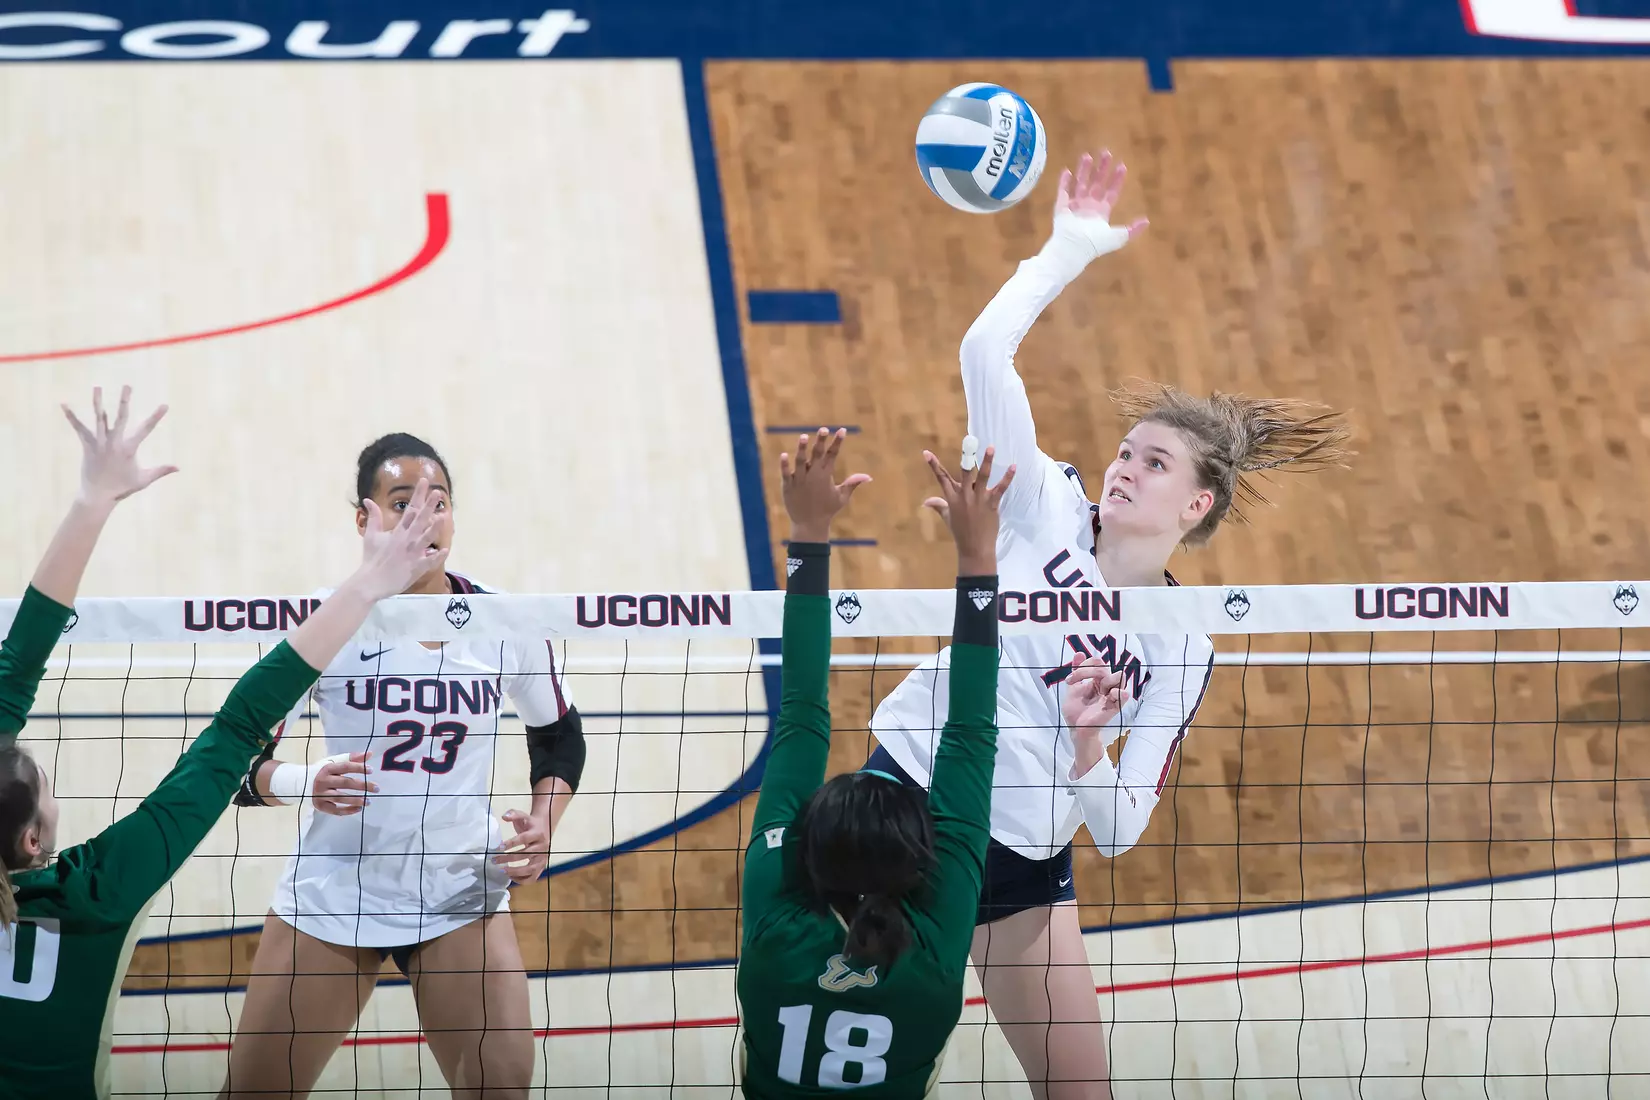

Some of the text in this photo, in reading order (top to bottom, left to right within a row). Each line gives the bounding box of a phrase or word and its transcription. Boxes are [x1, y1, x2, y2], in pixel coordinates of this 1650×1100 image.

[0, 10, 590, 59] Court
[986, 107, 1013, 177] molten
[1008, 115, 1033, 181] NCAA
[576, 594, 732, 628] UCONN
[967, 588, 995, 599] adidas
[997, 590, 1121, 623] CONN
[1355, 586, 1510, 620] UCONN
[1043, 548, 1152, 701] UNN
[345, 676, 503, 715] UCONN
[380, 719, 469, 775] 23
[777, 1003, 894, 1091] 18
